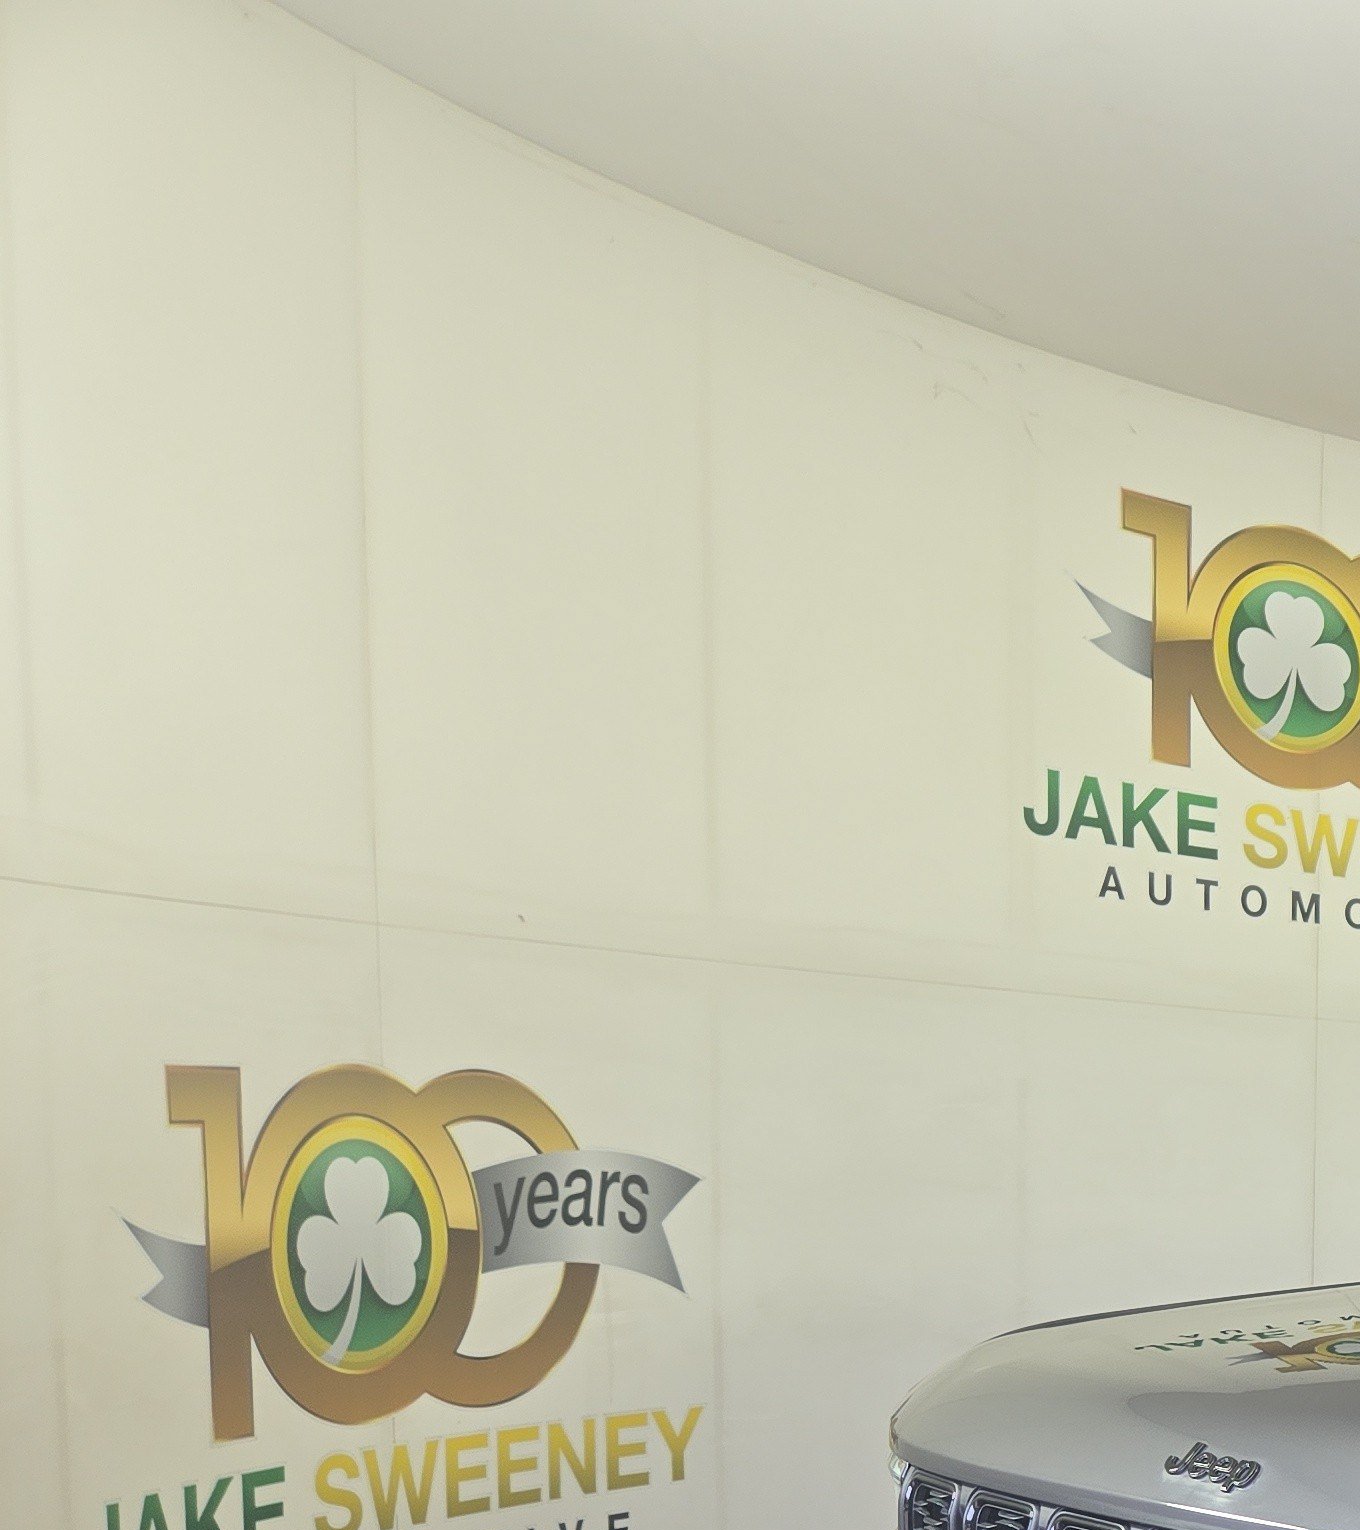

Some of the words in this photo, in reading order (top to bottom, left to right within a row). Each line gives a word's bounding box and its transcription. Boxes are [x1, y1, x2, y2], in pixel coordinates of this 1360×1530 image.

[1023, 768, 1219, 860] JAKE
[165, 1064, 600, 1441] 100
[493, 1168, 649, 1255] years
[1164, 1441, 1261, 1494] Jeep
